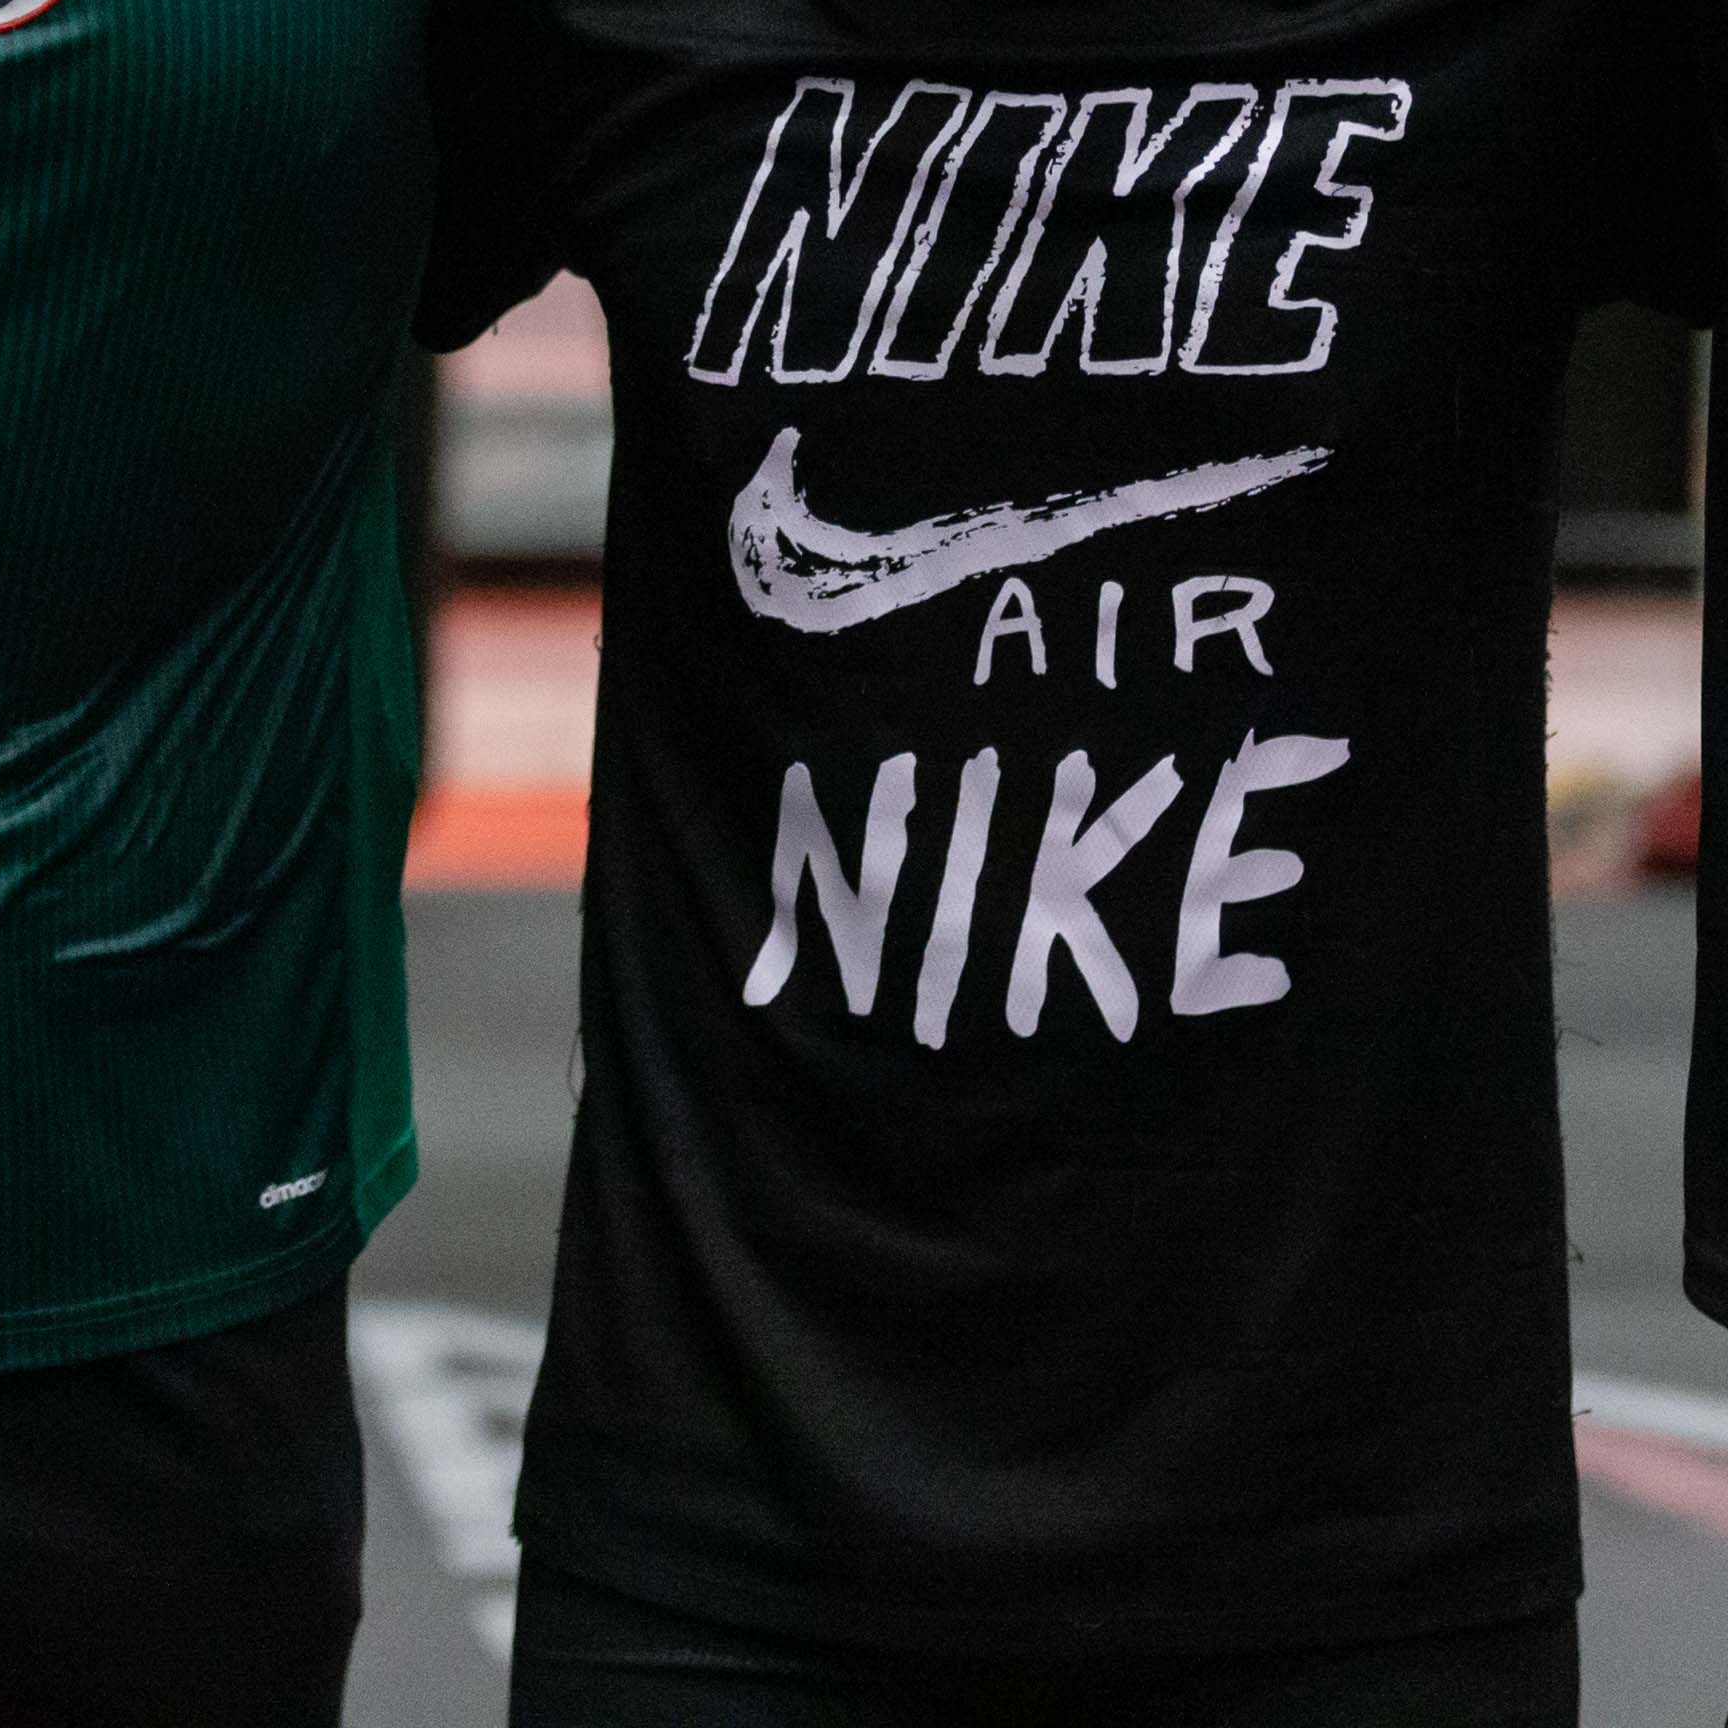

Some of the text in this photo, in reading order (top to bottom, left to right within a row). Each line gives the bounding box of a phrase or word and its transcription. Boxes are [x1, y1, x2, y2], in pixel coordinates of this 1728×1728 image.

[683, 78, 1412, 385] NIKE
[974, 576, 1275, 689] AIR
[743, 729, 1350, 1050] NIKE
